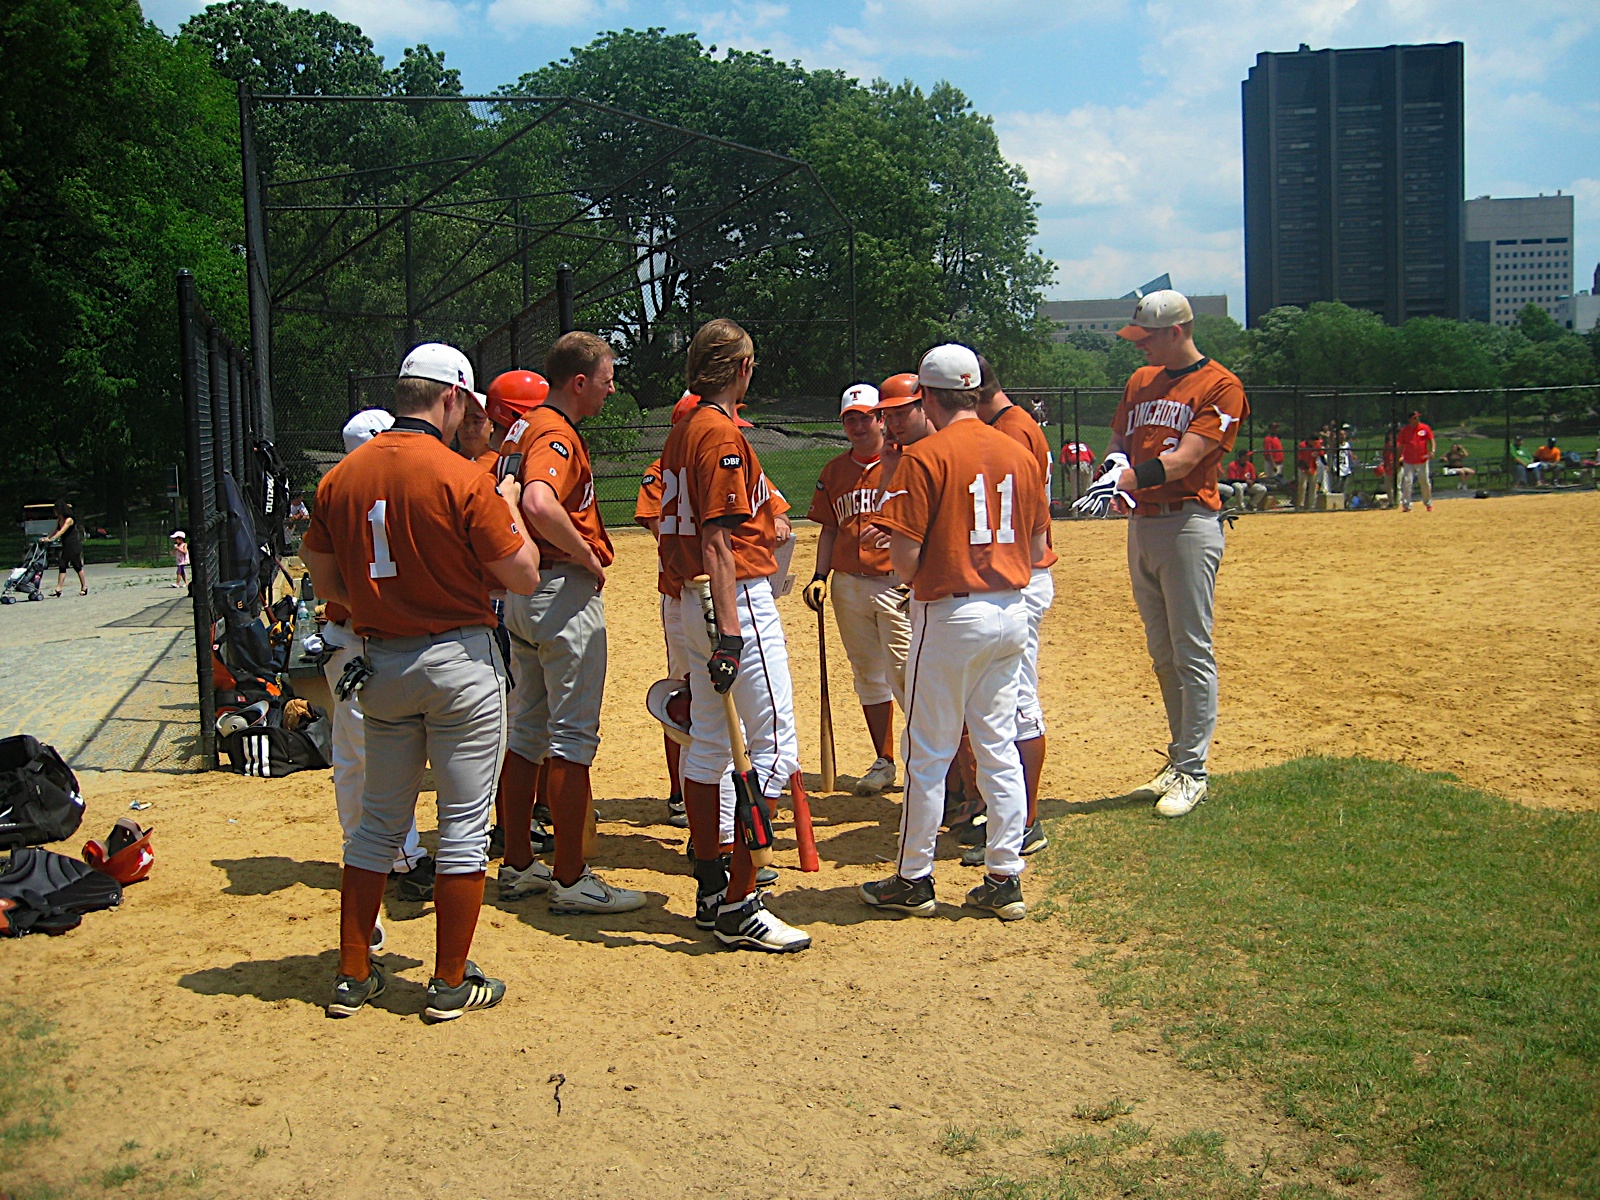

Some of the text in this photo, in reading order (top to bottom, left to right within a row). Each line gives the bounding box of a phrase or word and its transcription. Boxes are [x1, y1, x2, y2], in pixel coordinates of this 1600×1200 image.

[960, 373, 972, 386] T
[849, 390, 861, 401] T
[552, 442, 567, 456] DBF
[1159, 437, 1180, 457] 2
[723, 457, 741, 466] DBF
[659, 467, 697, 536] 24
[968, 472, 1016, 544] 11
[367, 499, 398, 579] 1
